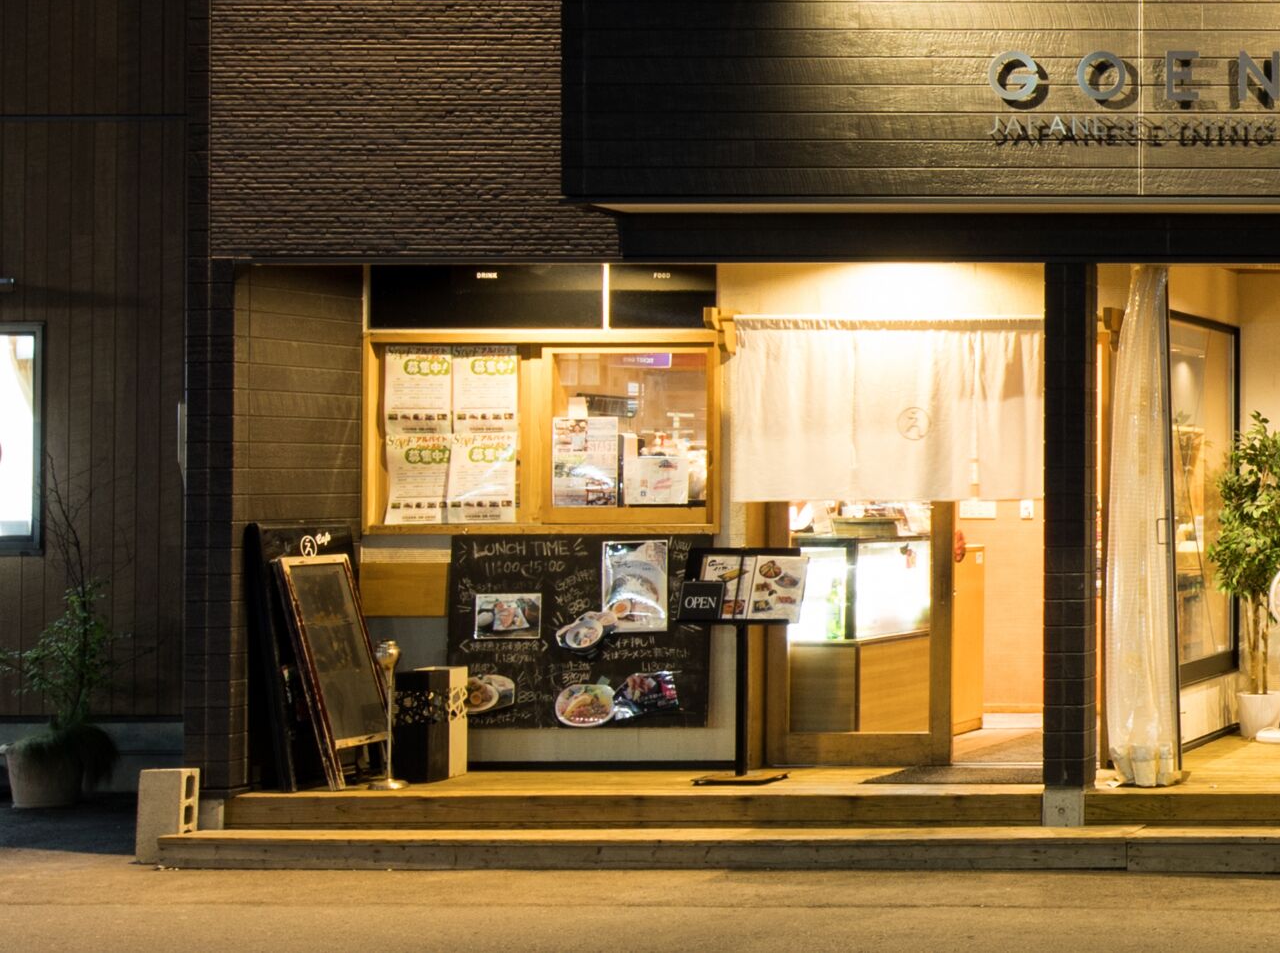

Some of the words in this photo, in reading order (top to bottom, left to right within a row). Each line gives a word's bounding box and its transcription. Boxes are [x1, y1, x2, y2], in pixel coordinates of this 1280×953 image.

[988, 50, 1280, 101] GOEN
[988, 115, 1145, 136] JAPANESE
[473, 541, 526, 558] LUNCH
[531, 540, 570, 557] TIME
[684, 596, 717, 609] OPEN
